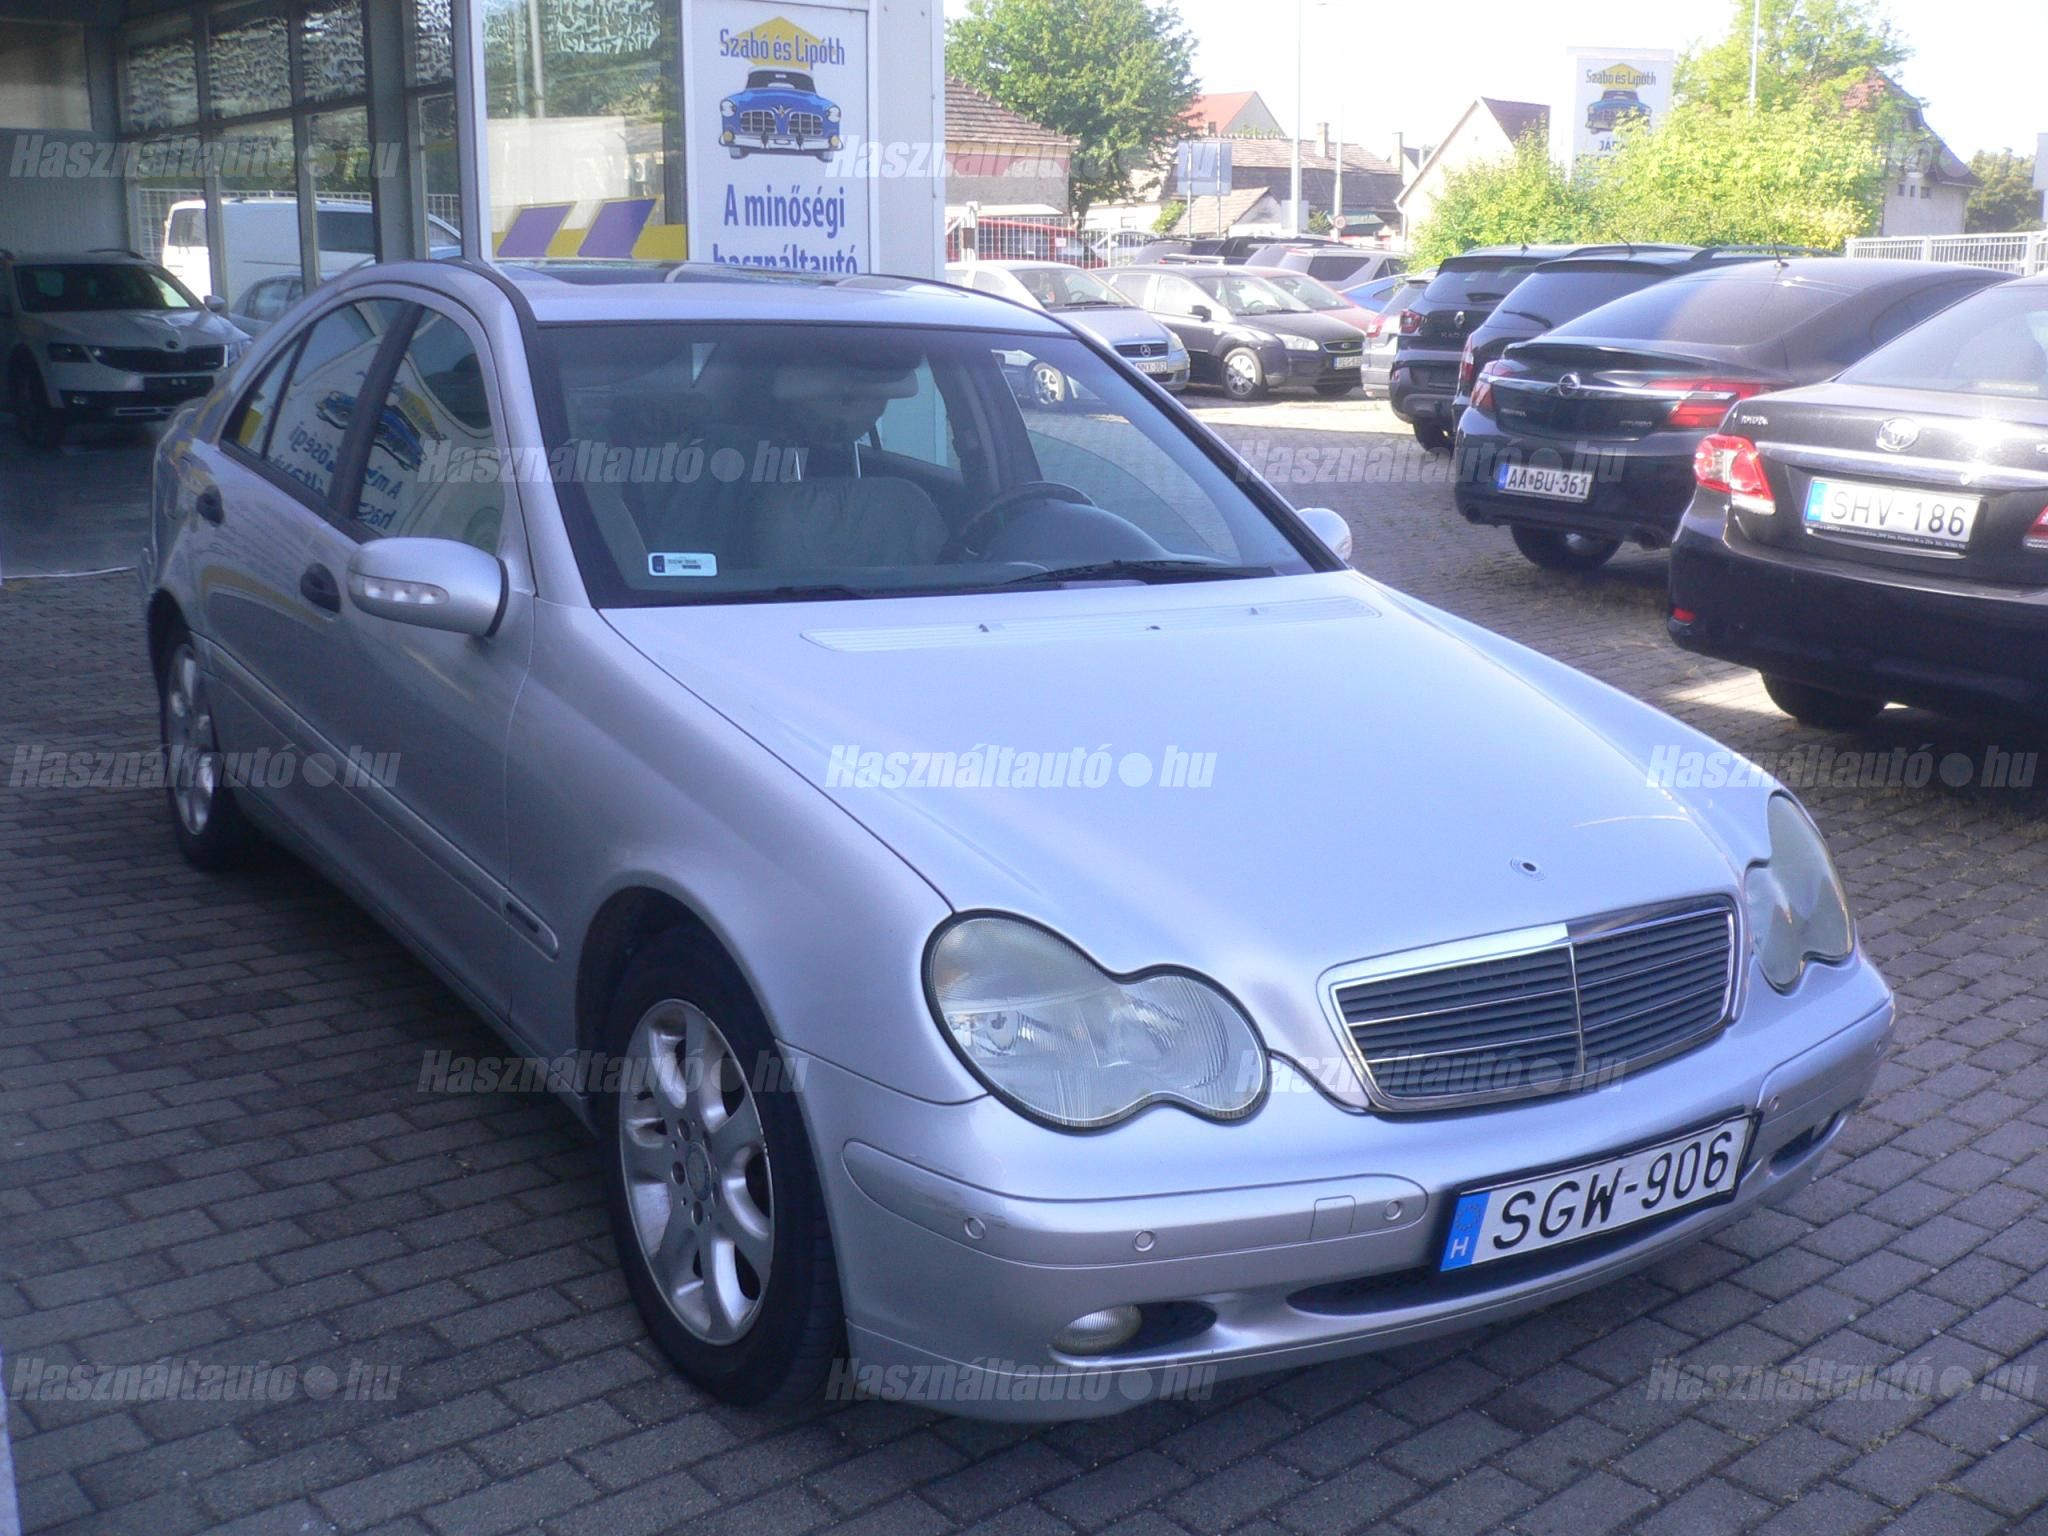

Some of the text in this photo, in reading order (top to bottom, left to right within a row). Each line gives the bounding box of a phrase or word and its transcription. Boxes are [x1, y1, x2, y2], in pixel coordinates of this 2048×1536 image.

[720, 28, 845, 70] Szabó és Lipóth
[724, 184, 845, 238] A minőségi
[1508, 468, 1588, 496] AA BU-361
[1831, 490, 1966, 537] SHV-186
[1450, 1131, 1733, 1259] H SGW-906
